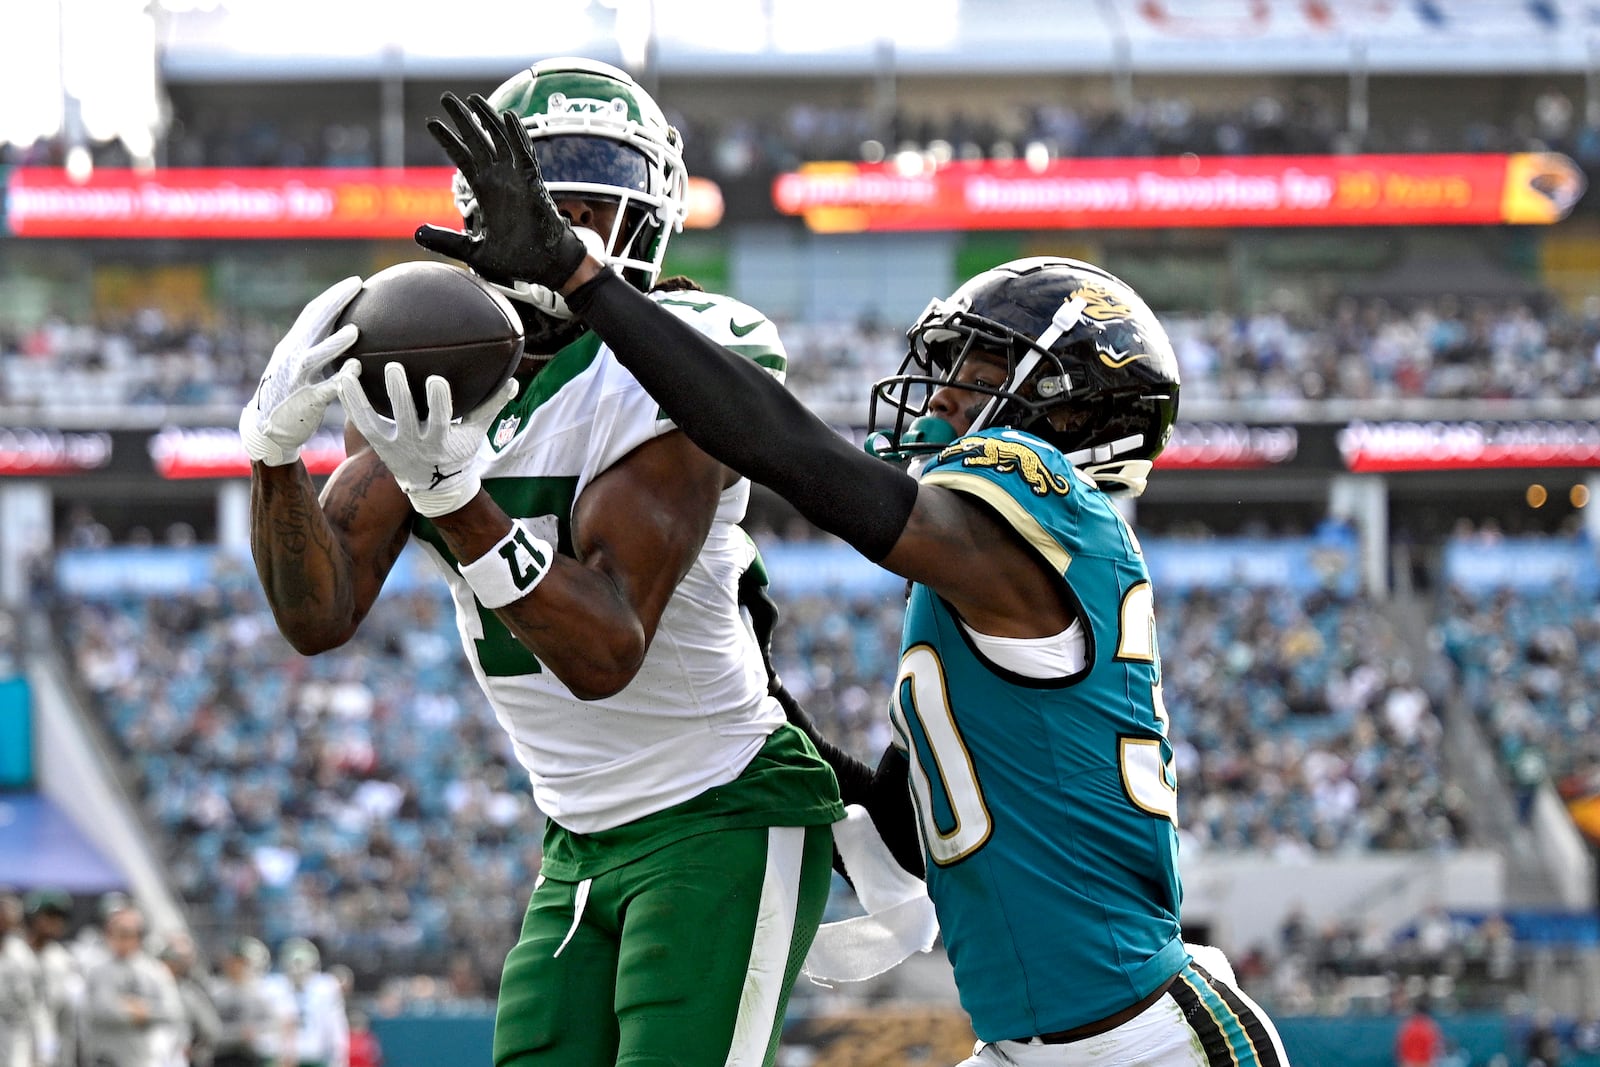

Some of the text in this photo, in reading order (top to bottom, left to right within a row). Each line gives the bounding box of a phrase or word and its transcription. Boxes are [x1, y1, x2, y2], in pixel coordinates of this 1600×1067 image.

[565, 103, 605, 113] NY
[498, 527, 546, 591] 17
[889, 641, 995, 866] 0
